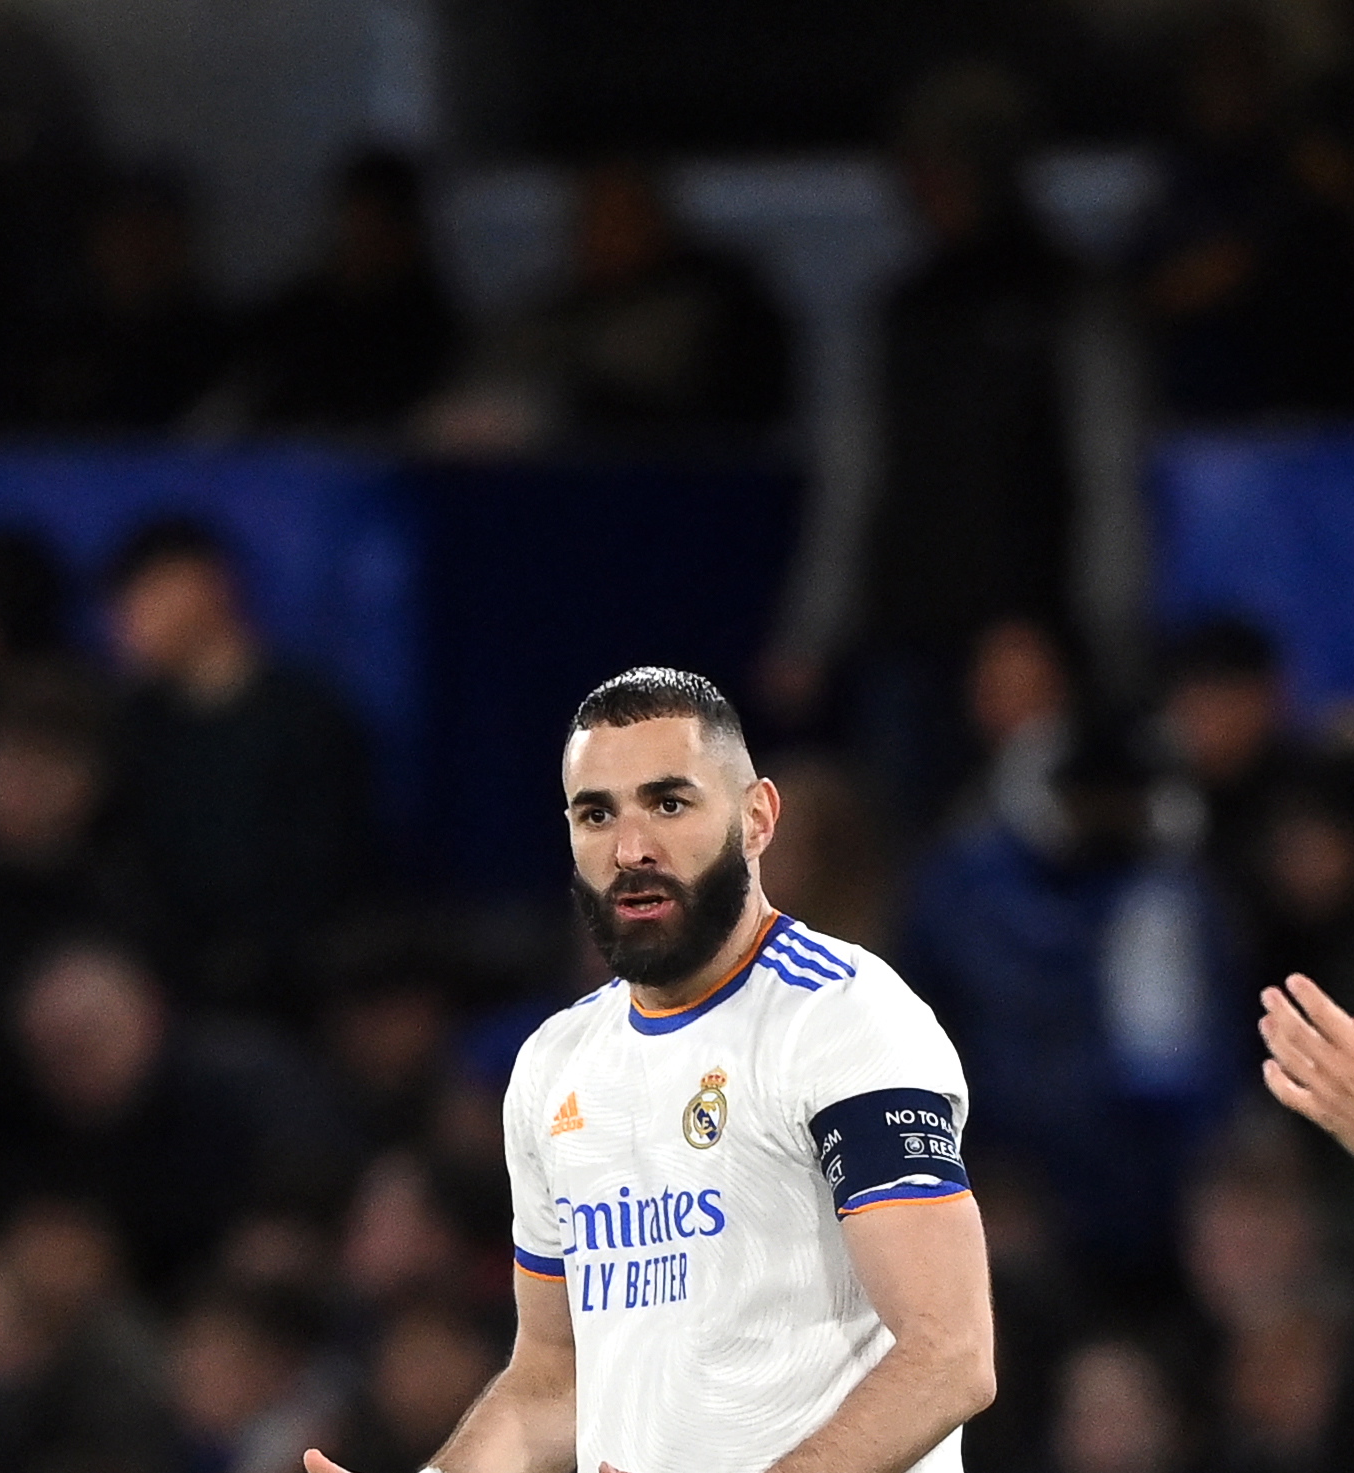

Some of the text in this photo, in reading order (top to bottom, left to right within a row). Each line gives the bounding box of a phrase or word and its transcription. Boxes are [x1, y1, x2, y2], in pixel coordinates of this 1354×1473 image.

[885, 1109, 916, 1126] NO
[917, 1109, 939, 1127] TO
[575, 1252, 688, 1312] LY BETTER
